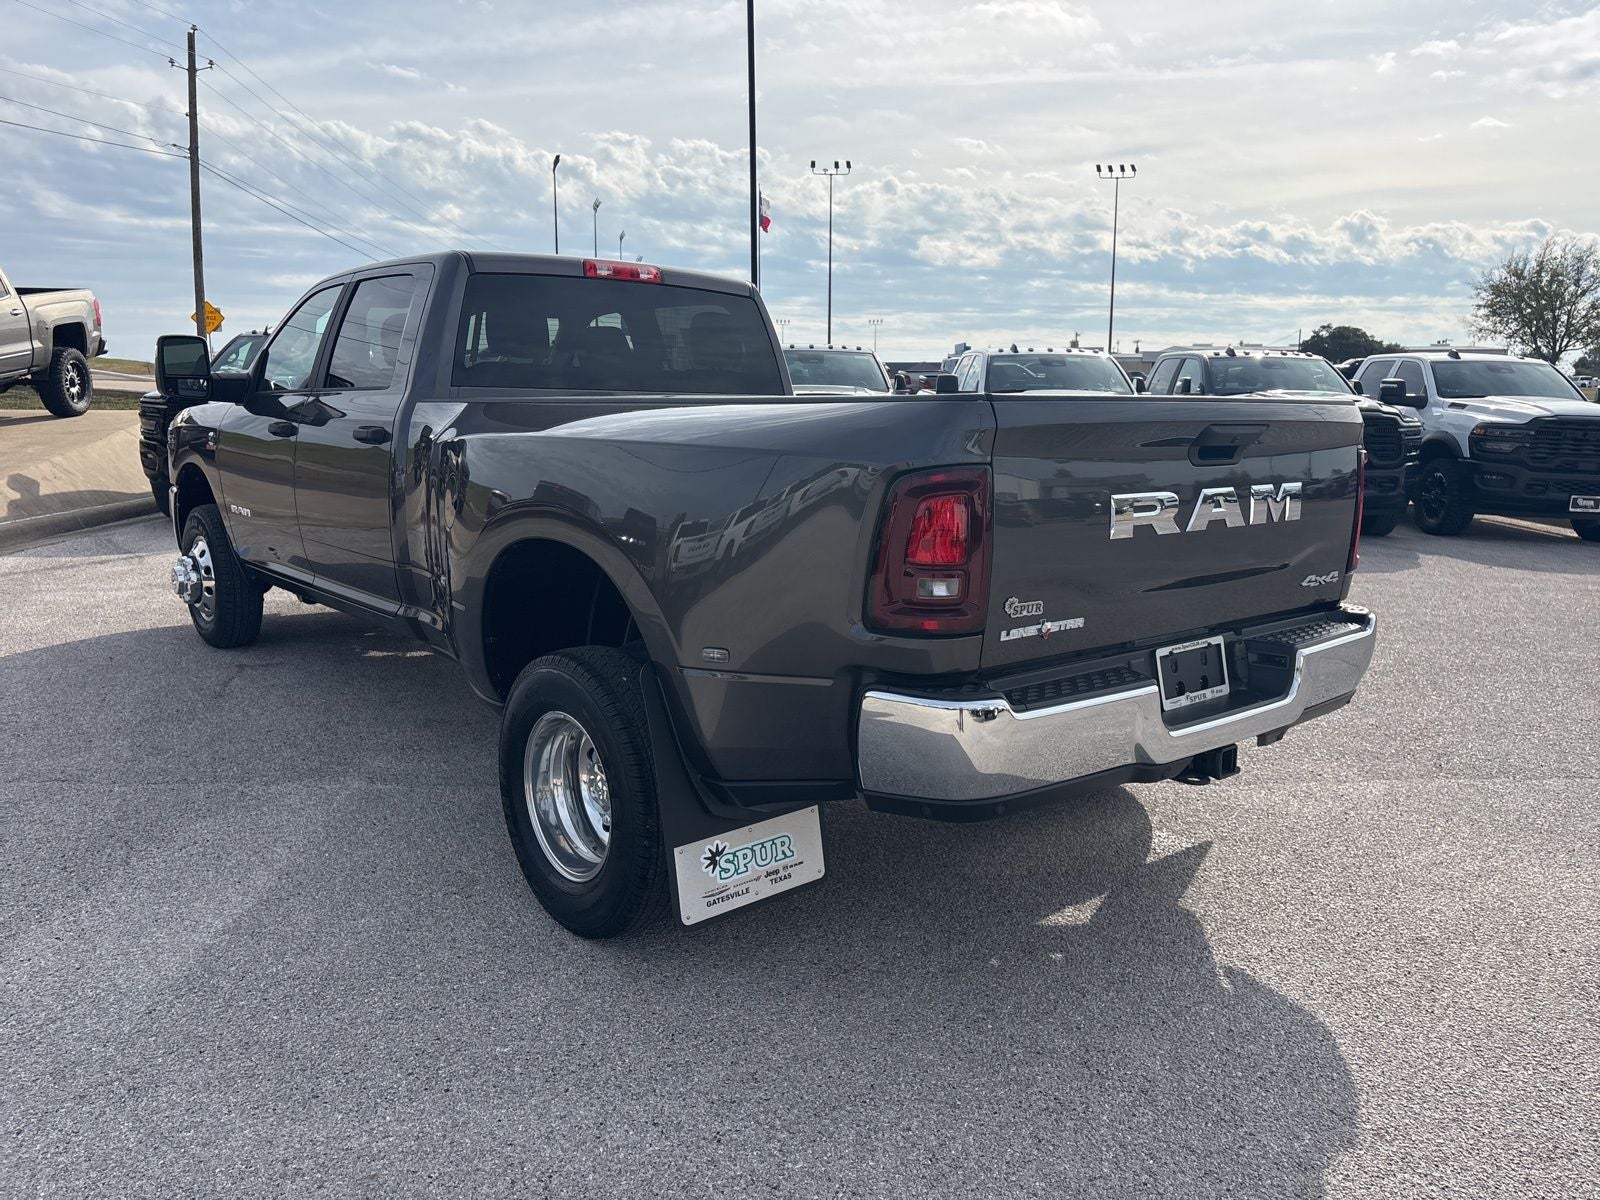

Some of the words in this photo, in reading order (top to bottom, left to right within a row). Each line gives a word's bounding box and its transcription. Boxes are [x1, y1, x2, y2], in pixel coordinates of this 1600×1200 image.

[230, 504, 251, 517] RAM
[1110, 481, 1303, 540] RAM
[1012, 601, 1043, 617] SPUR
[1000, 625, 1039, 642] LONE
[1050, 618, 1085, 632] STAR
[1190, 693, 1207, 703] SPUR
[718, 834, 795, 880] SPUR
[764, 867, 780, 879] Jeep
[706, 887, 750, 907] GATESVILLE
[769, 872, 792, 886] TEXAS
